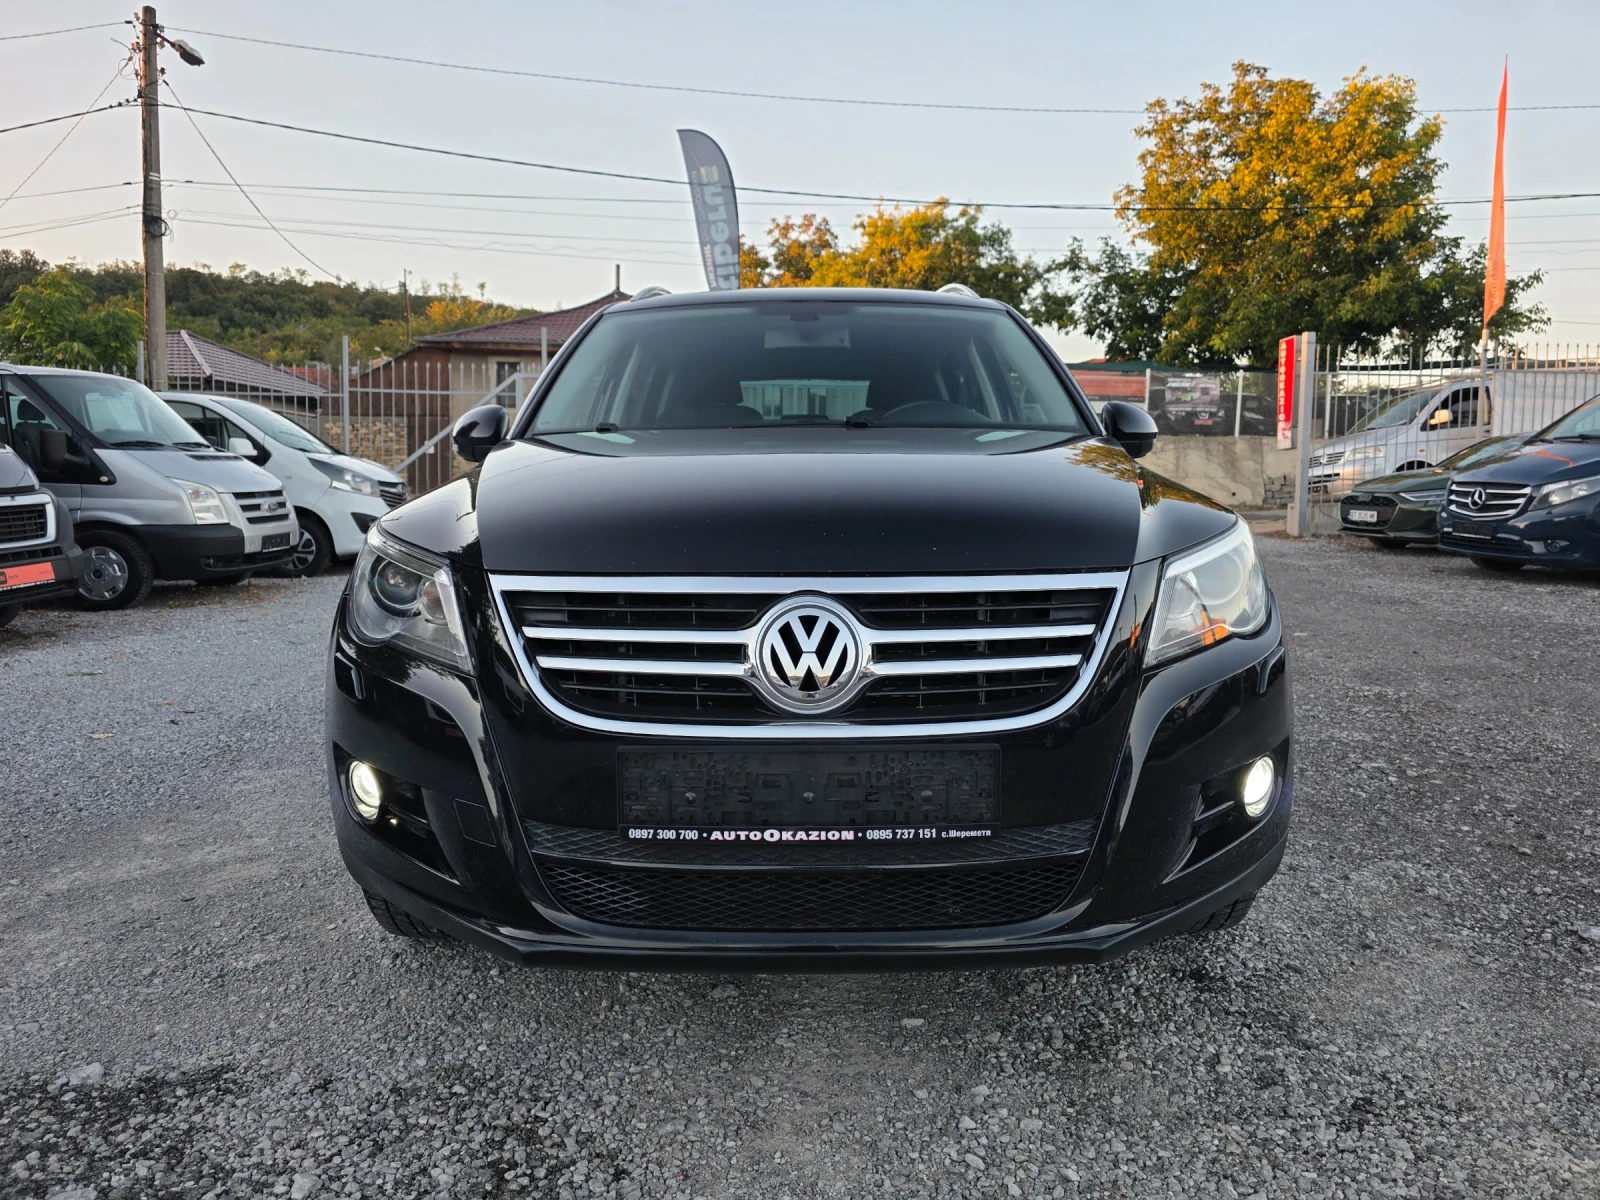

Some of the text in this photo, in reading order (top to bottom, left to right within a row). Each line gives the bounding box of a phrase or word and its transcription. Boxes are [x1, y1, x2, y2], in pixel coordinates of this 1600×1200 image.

[628, 828, 654, 839] 0897
[656, 829, 676, 840] 300
[678, 830, 698, 840] 700
[710, 829, 854, 842] AUTOOKAZION
[866, 829, 892, 840] 0895
[895, 829, 914, 839] 737
[918, 828, 936, 838] 151
